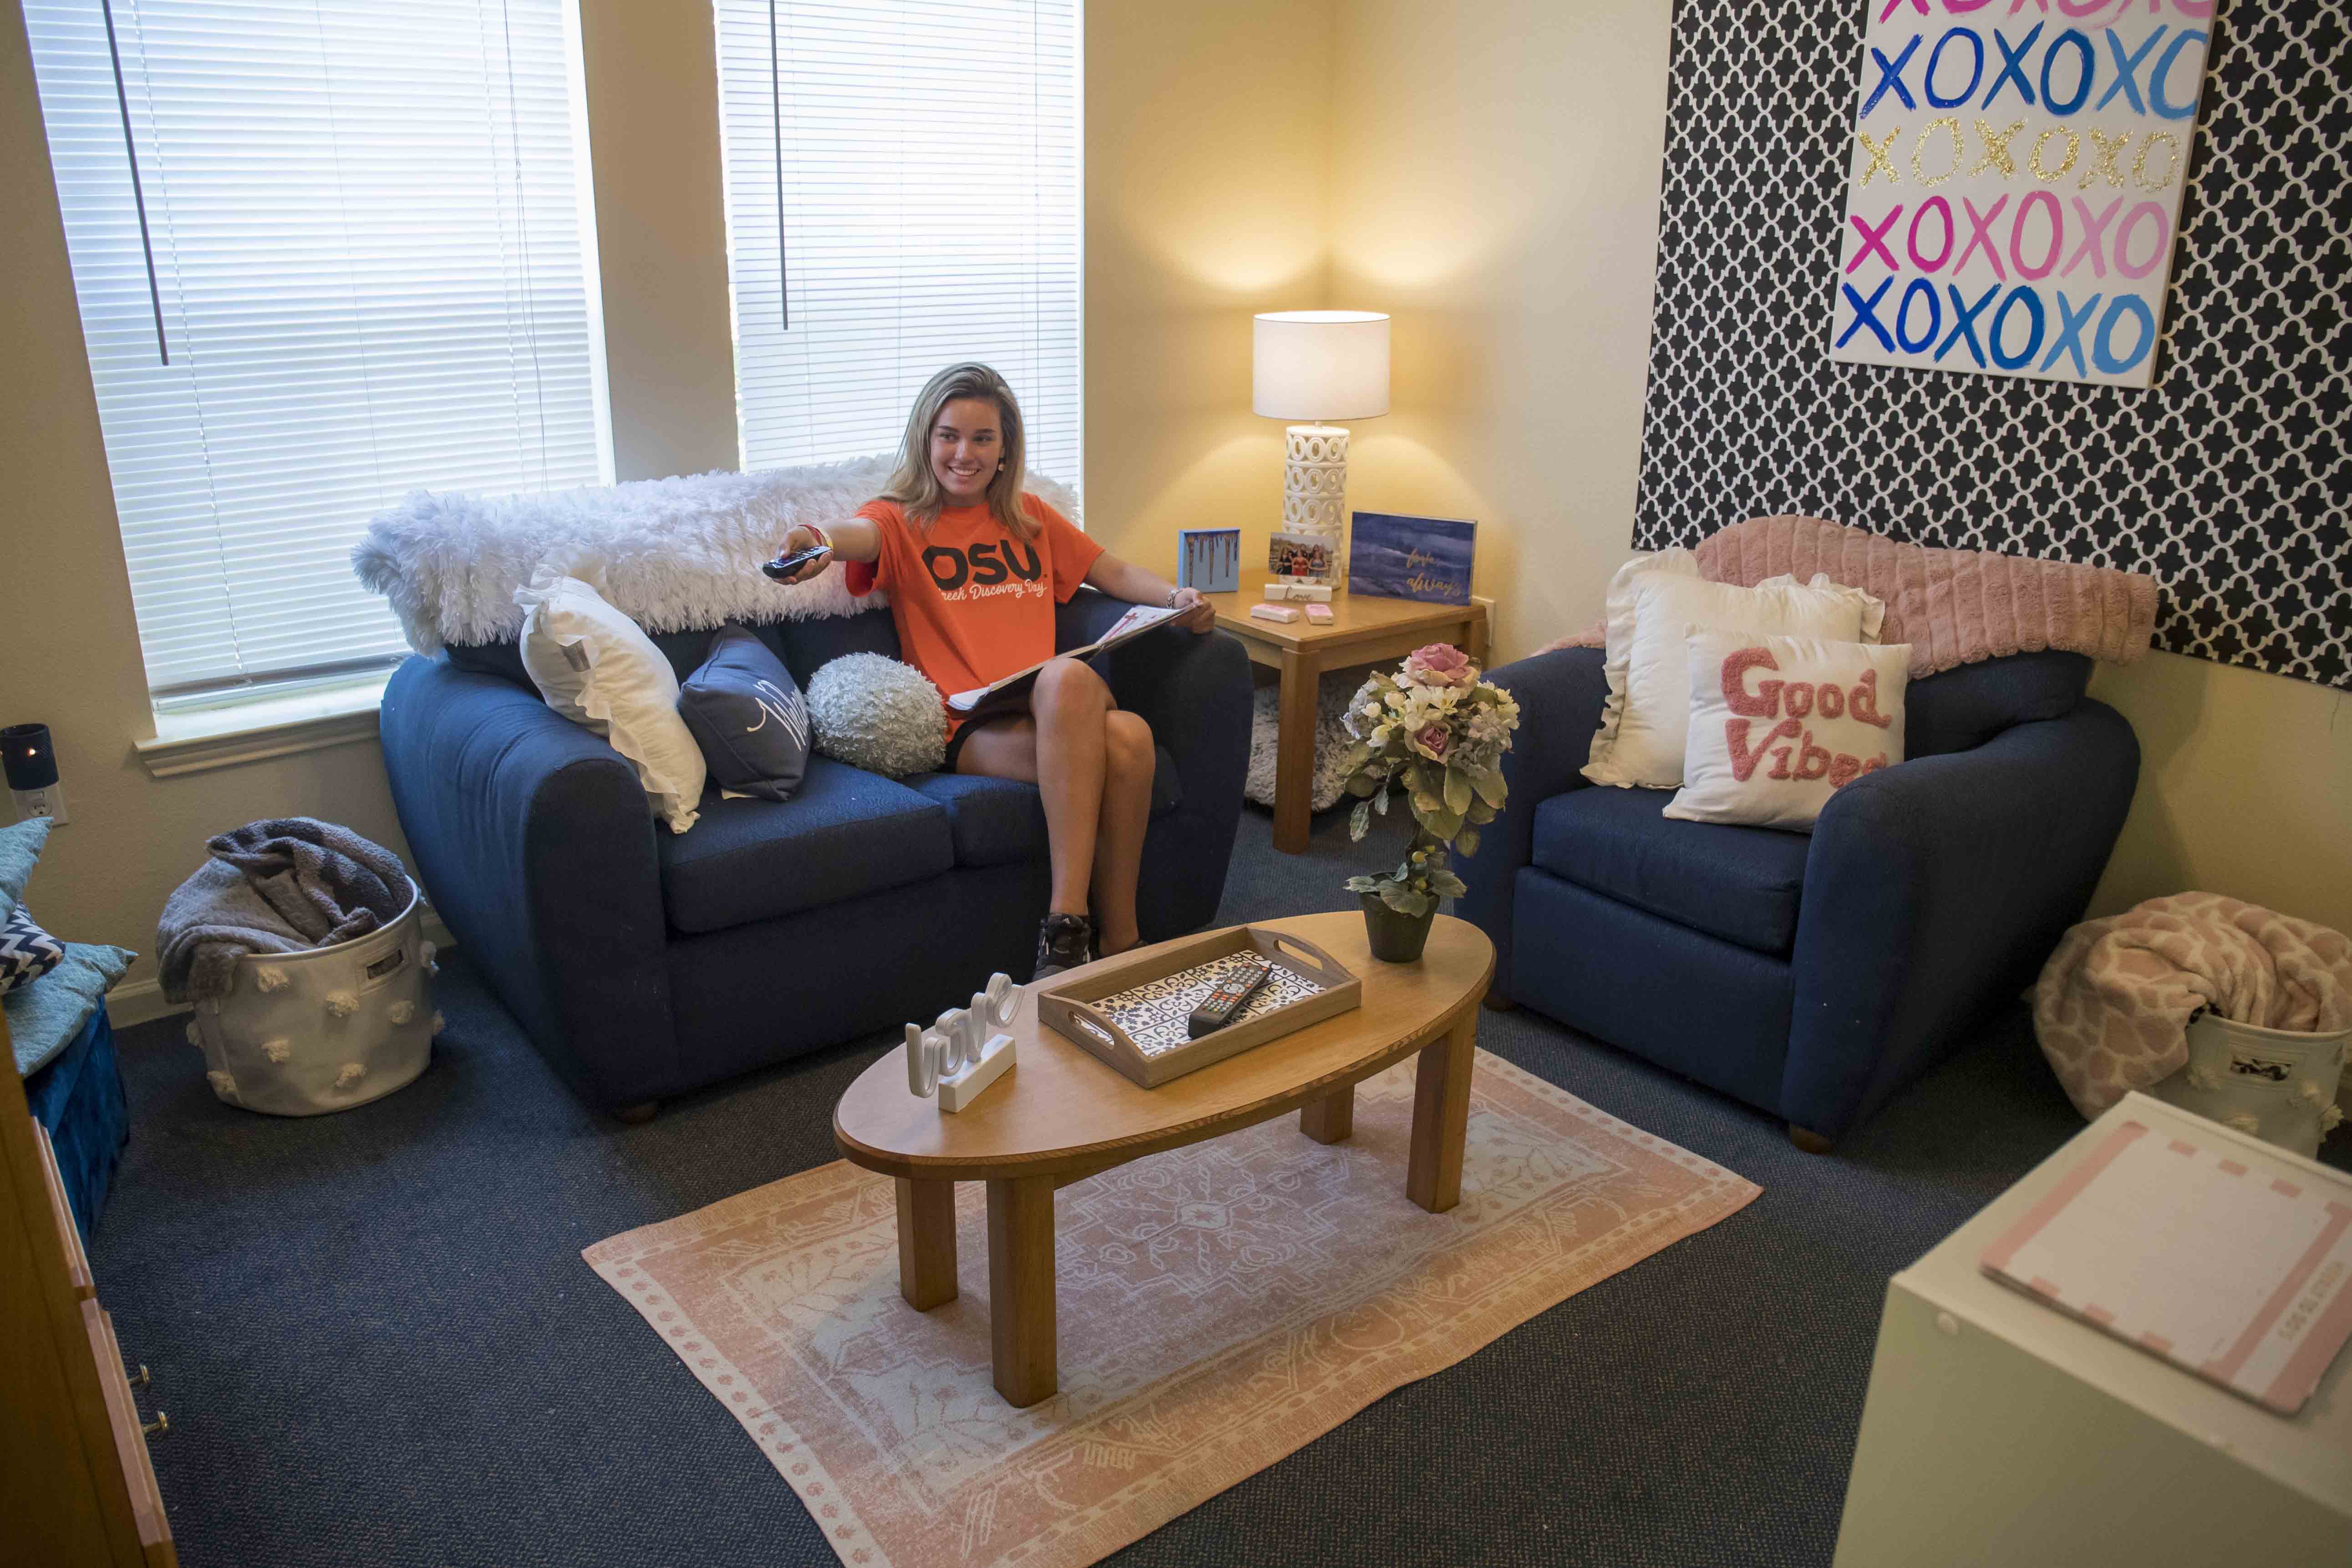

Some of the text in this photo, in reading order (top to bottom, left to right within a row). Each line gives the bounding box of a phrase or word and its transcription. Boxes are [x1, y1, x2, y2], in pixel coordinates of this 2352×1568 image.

[1857, 116, 2182, 193] XOXOXO
[1845, 190, 2169, 281] XOXOXO
[1835, 274, 2155, 379] XOXOXO
[921, 539, 1042, 591] OSU
[941, 578, 1047, 601] reek Discovery Day
[1721, 647, 1892, 729] Good
